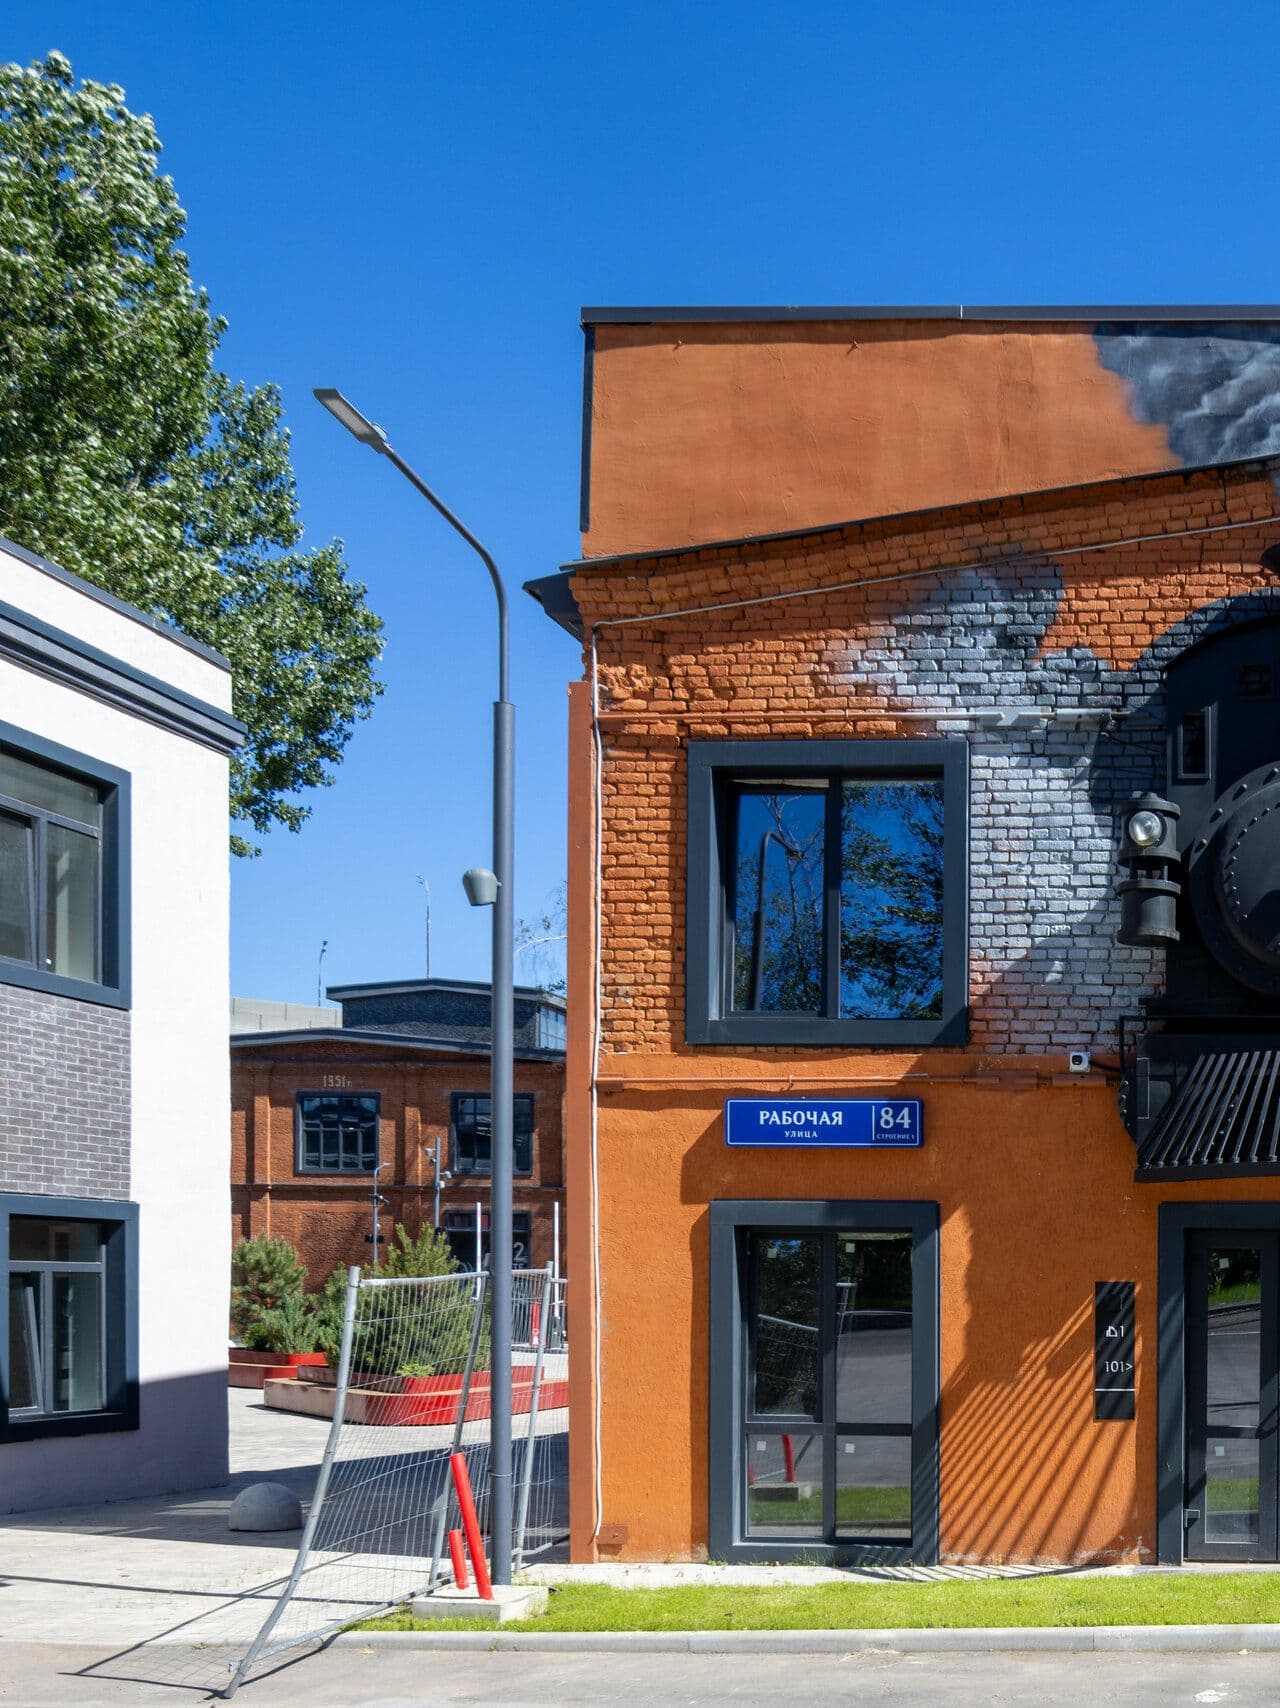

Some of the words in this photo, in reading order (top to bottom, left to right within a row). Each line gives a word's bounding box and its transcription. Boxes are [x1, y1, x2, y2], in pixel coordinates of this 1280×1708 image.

[760, 1110, 843, 1125] РАБОЧАЯ
[880, 1107, 911, 1128] 84
[784, 1130, 818, 1138] УЛИЦА
[1120, 1325, 1124, 1338] 1
